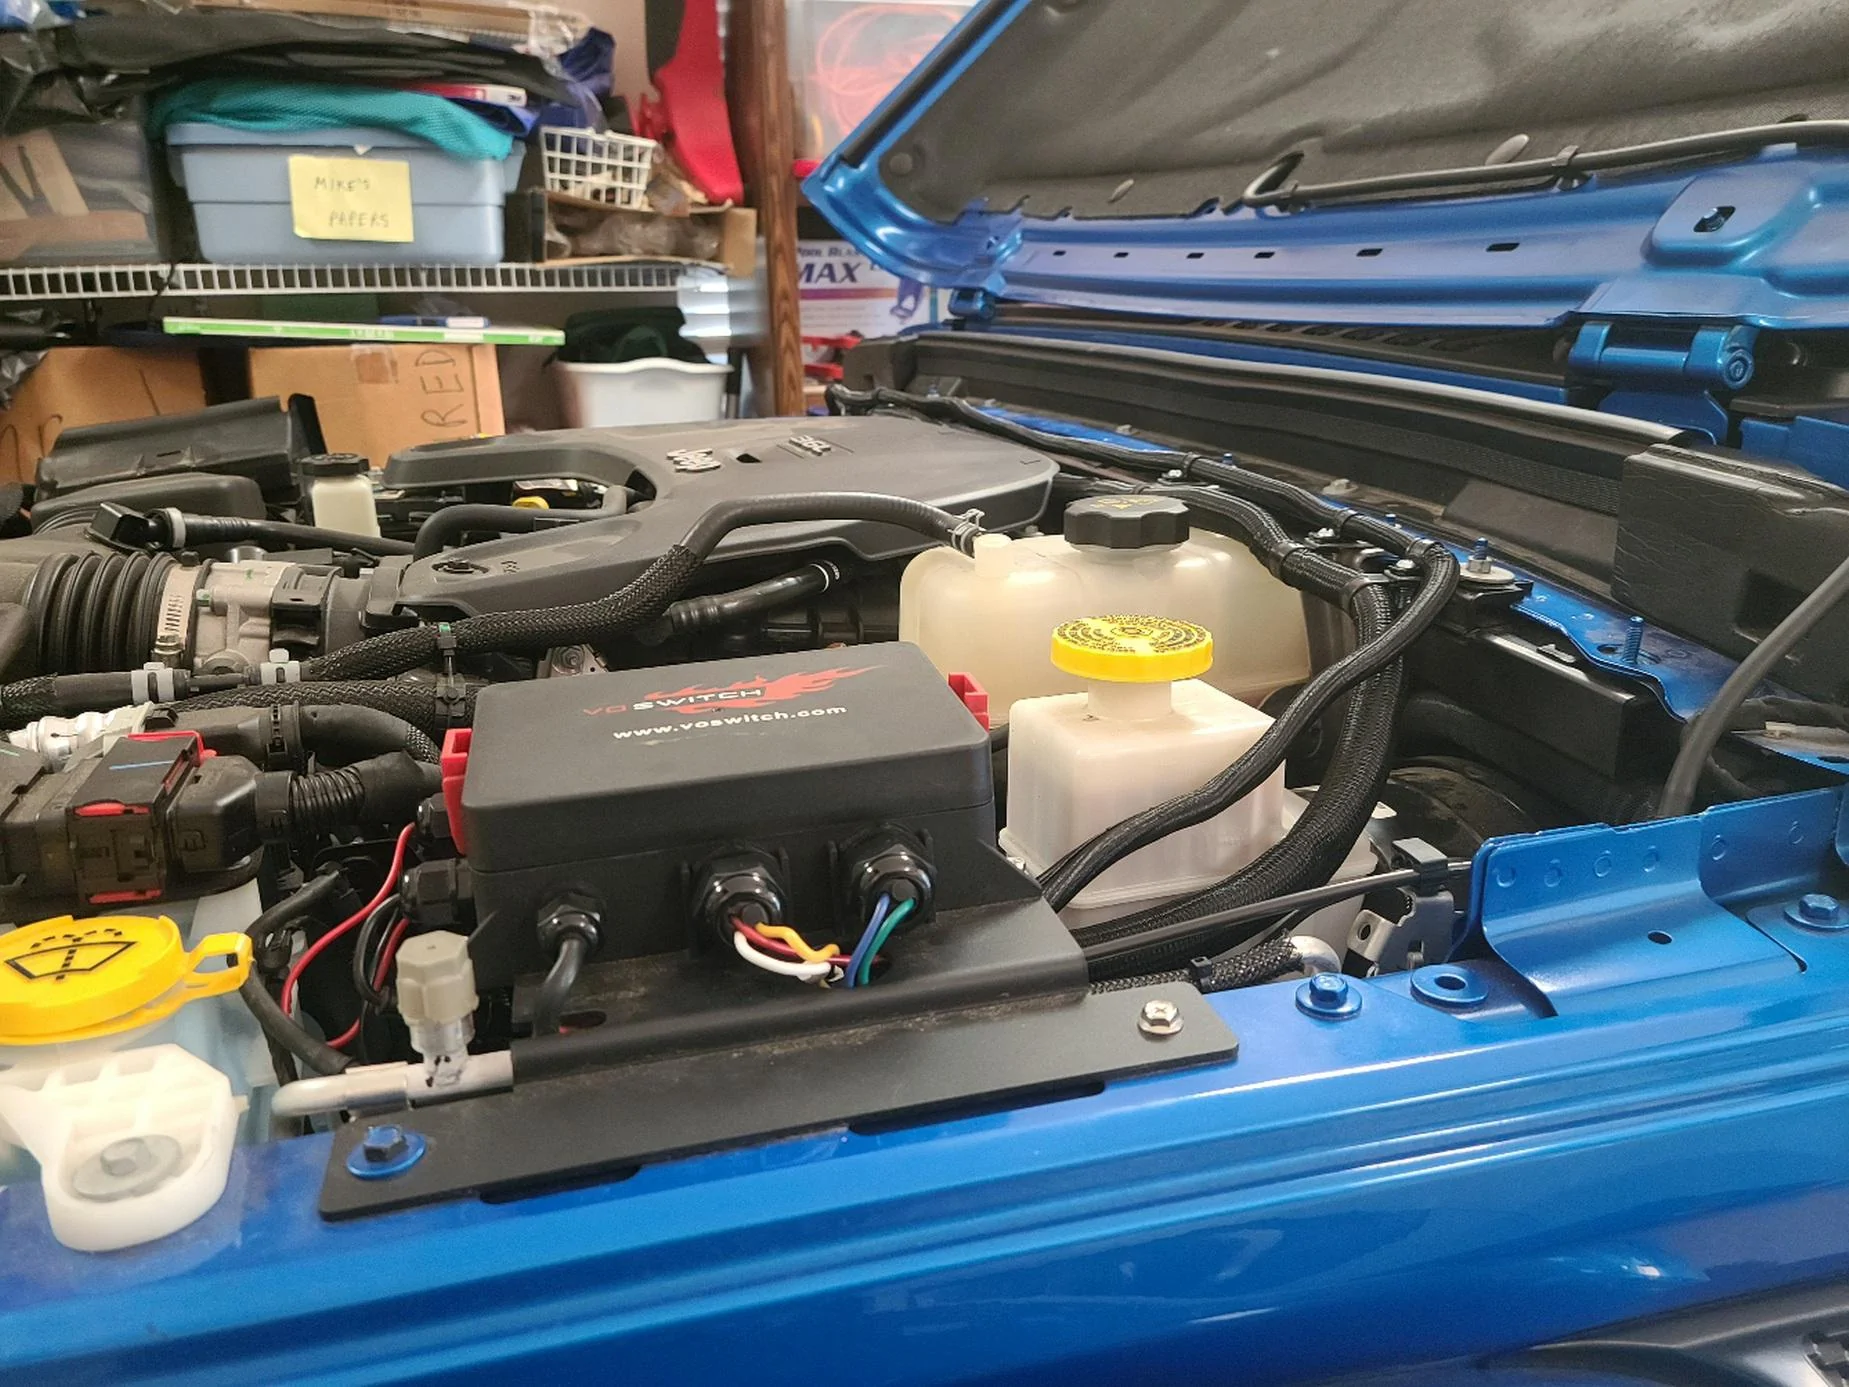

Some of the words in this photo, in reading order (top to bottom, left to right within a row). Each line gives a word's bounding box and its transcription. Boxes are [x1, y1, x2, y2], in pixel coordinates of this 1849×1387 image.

[314, 176, 371, 192] MIKE'S
[329, 210, 389, 228] PAPERS
[415, 350, 468, 427] RED
[613, 705, 848, 740] www.voswitch.com
